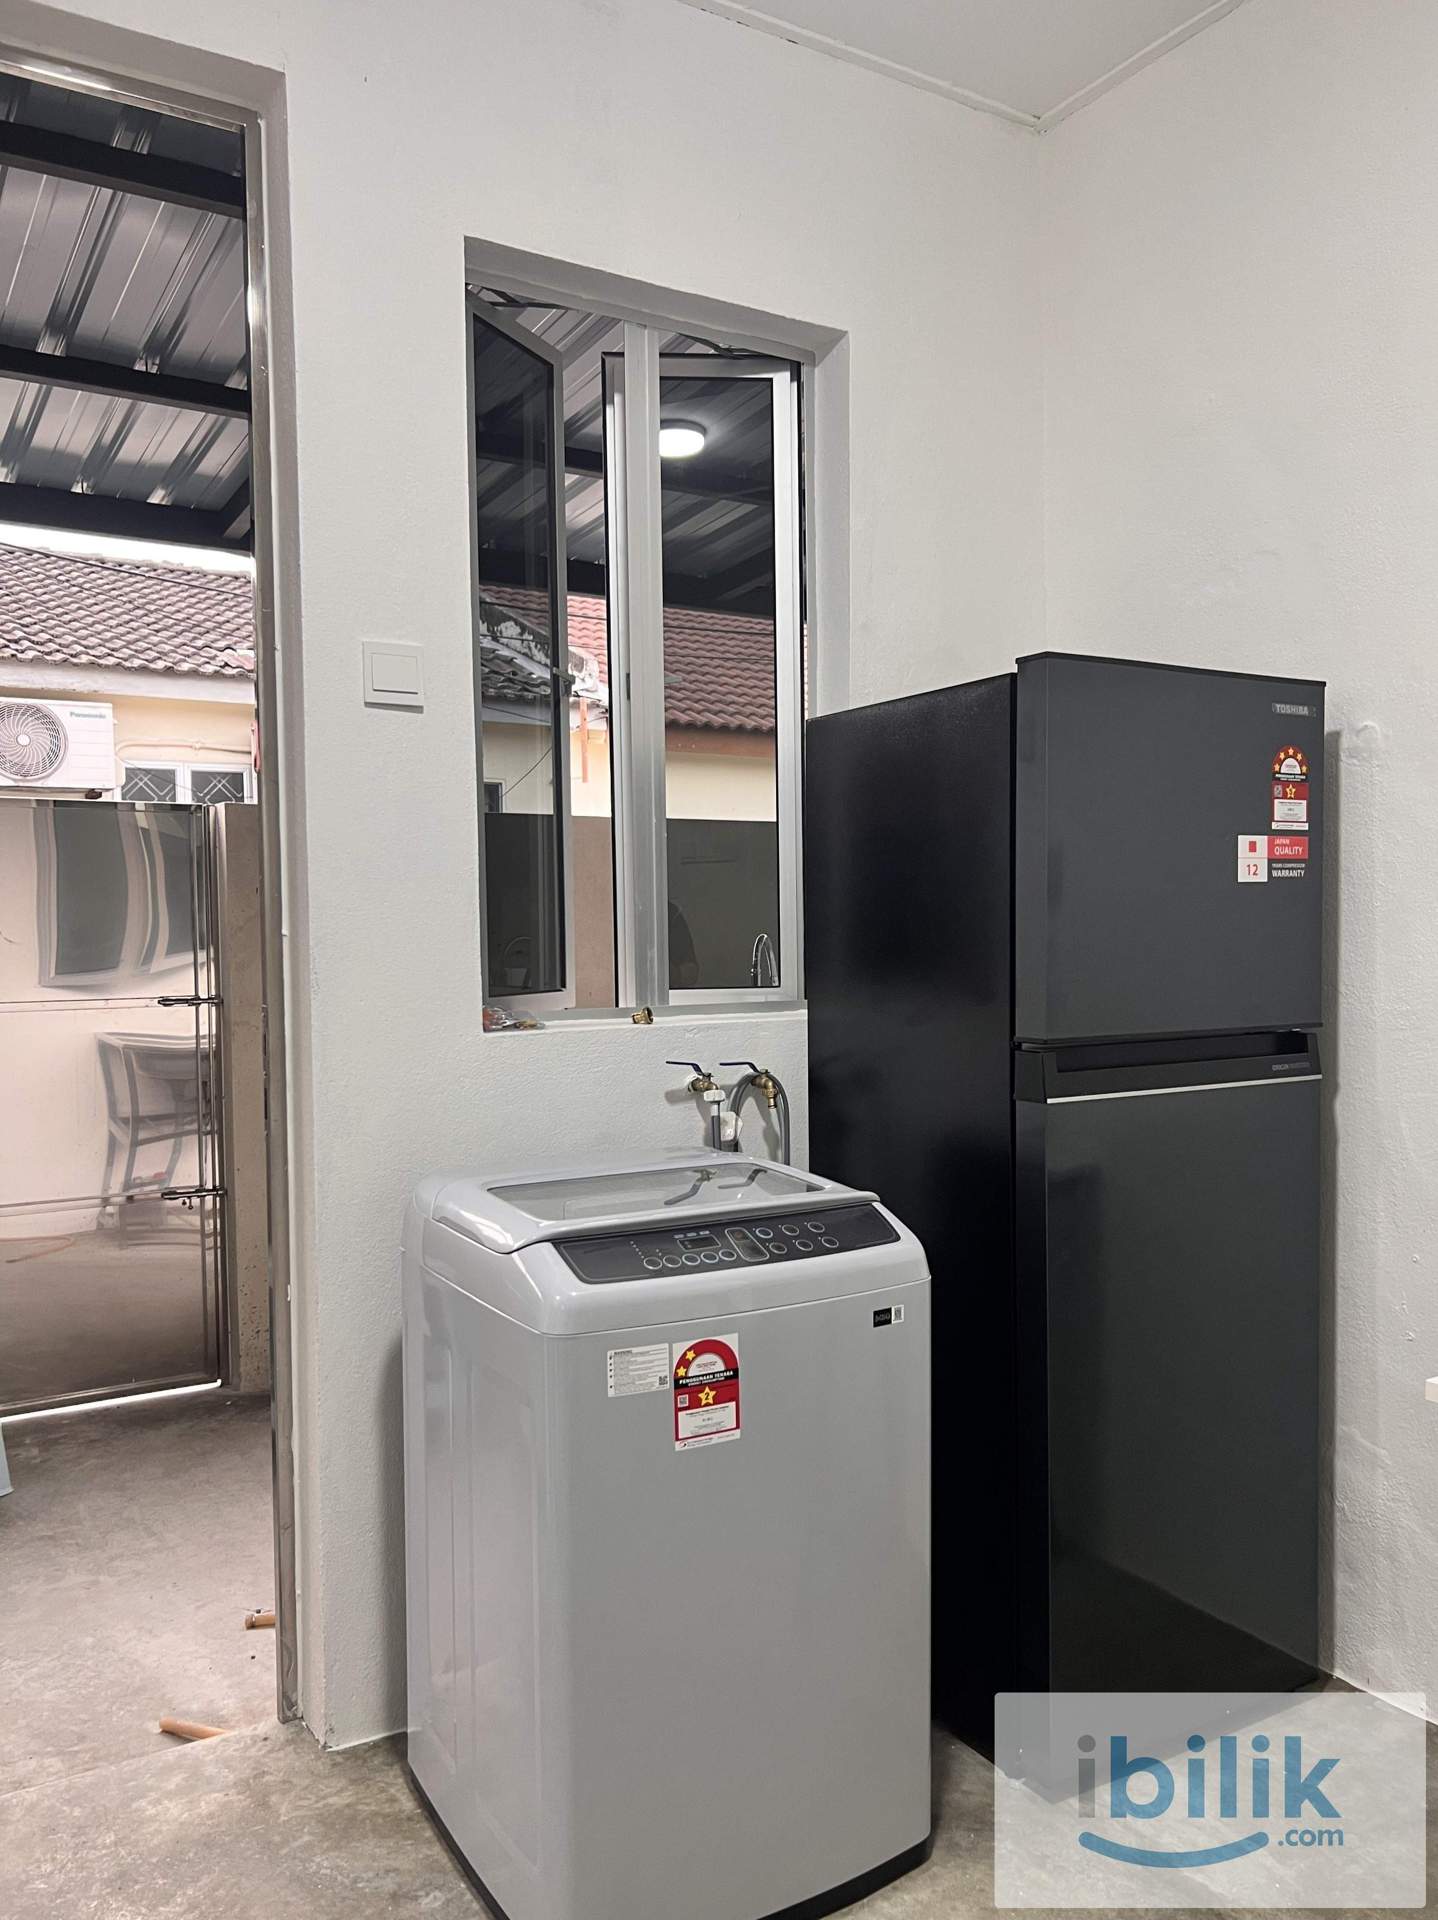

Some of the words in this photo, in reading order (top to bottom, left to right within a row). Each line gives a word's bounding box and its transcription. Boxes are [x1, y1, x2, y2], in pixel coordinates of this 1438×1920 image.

[1275, 703, 1309, 716] TOSHIBA
[1274, 846, 1303, 856] QUALITY
[1246, 864, 1259, 876] 12
[1271, 869, 1305, 878] WARRANTY
[704, 1392, 710, 1401] 2
